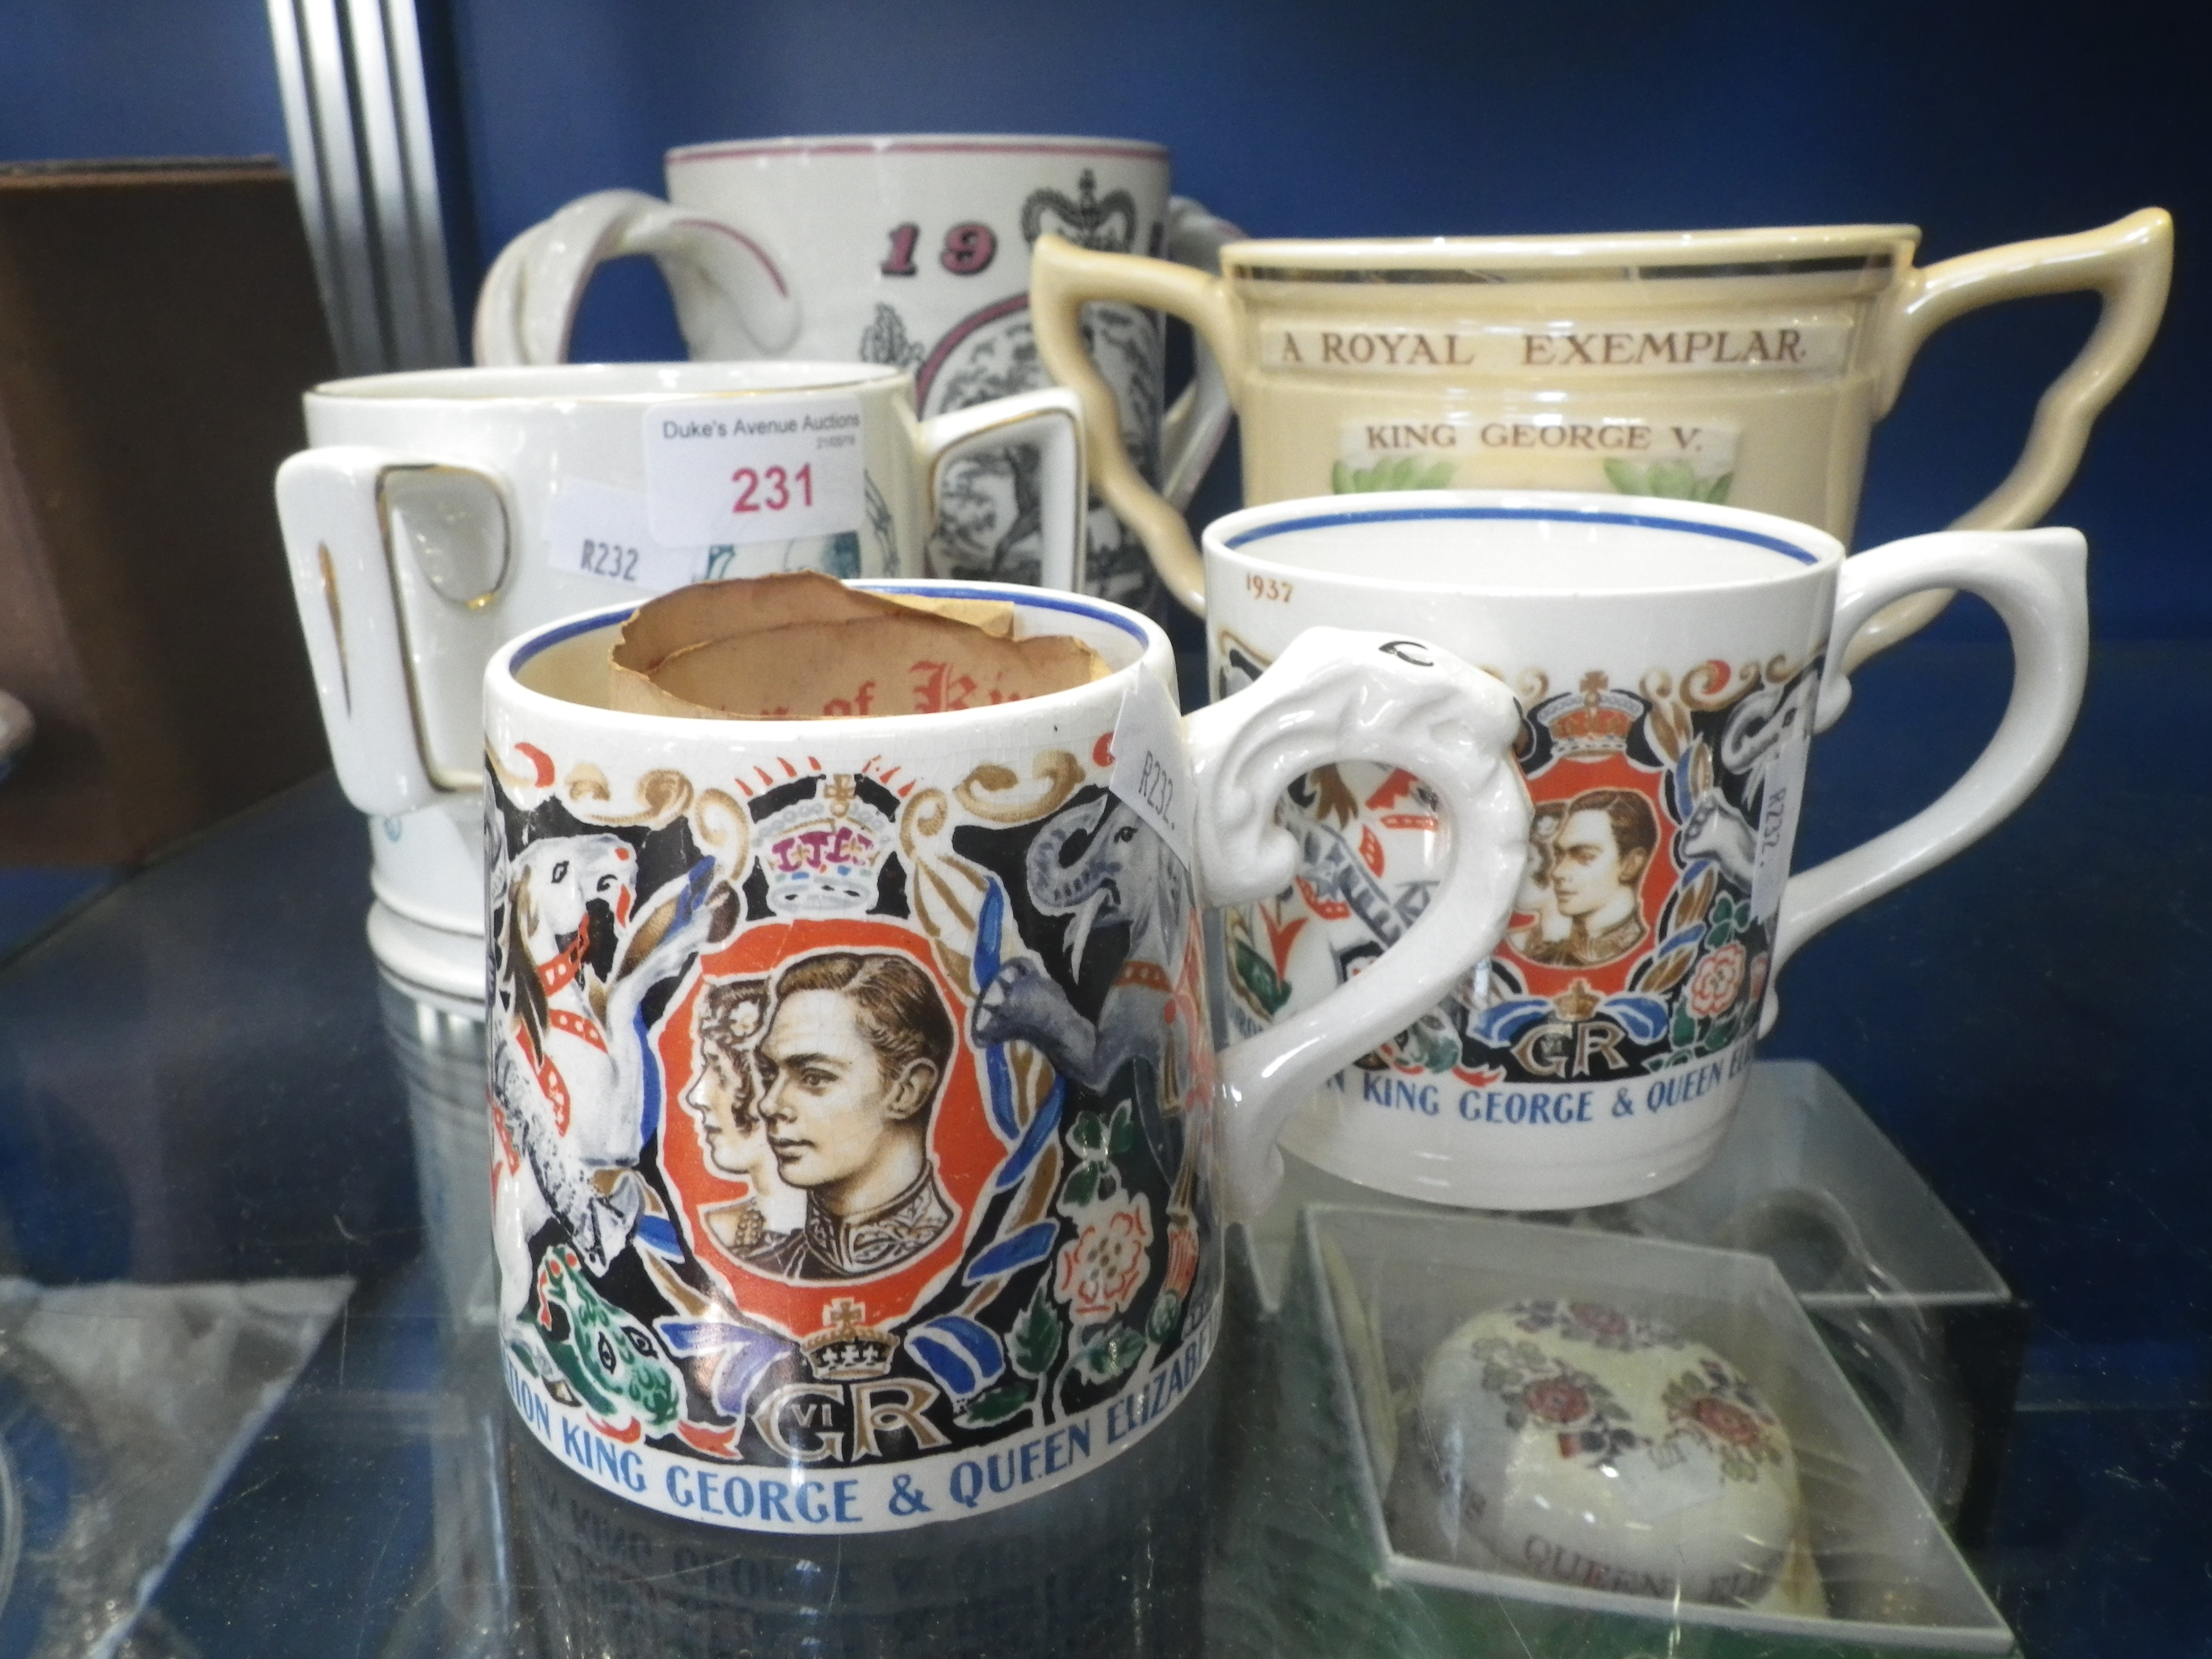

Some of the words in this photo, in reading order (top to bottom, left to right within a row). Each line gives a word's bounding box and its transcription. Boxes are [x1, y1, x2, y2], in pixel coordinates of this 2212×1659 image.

[1282, 331, 1303, 362] A
[1321, 332, 1475, 364] ROYAL
[663, 419, 727, 439] Duke's
[734, 417, 798, 436] Avenue
[803, 413, 860, 432] Auctions
[1367, 422, 1457, 450] KING
[1481, 422, 1651, 451] GEORGE
[732, 463, 813, 513] 231
[580, 539, 639, 581] R232
[1246, 572, 1293, 603] 1937
[1363, 1071, 1439, 1116] KING
[1459, 1089, 1593, 1124] GEORGE
[1611, 1086, 1634, 1118] &
[1646, 1060, 1722, 1113] QUEEN
[751, 1377, 968, 1463] GR
[562, 1416, 647, 1493] KING
[666, 1466, 863, 1523] GEORGE
[888, 1474, 931, 1516] &
[950, 1424, 1091, 1507] QUEEN
